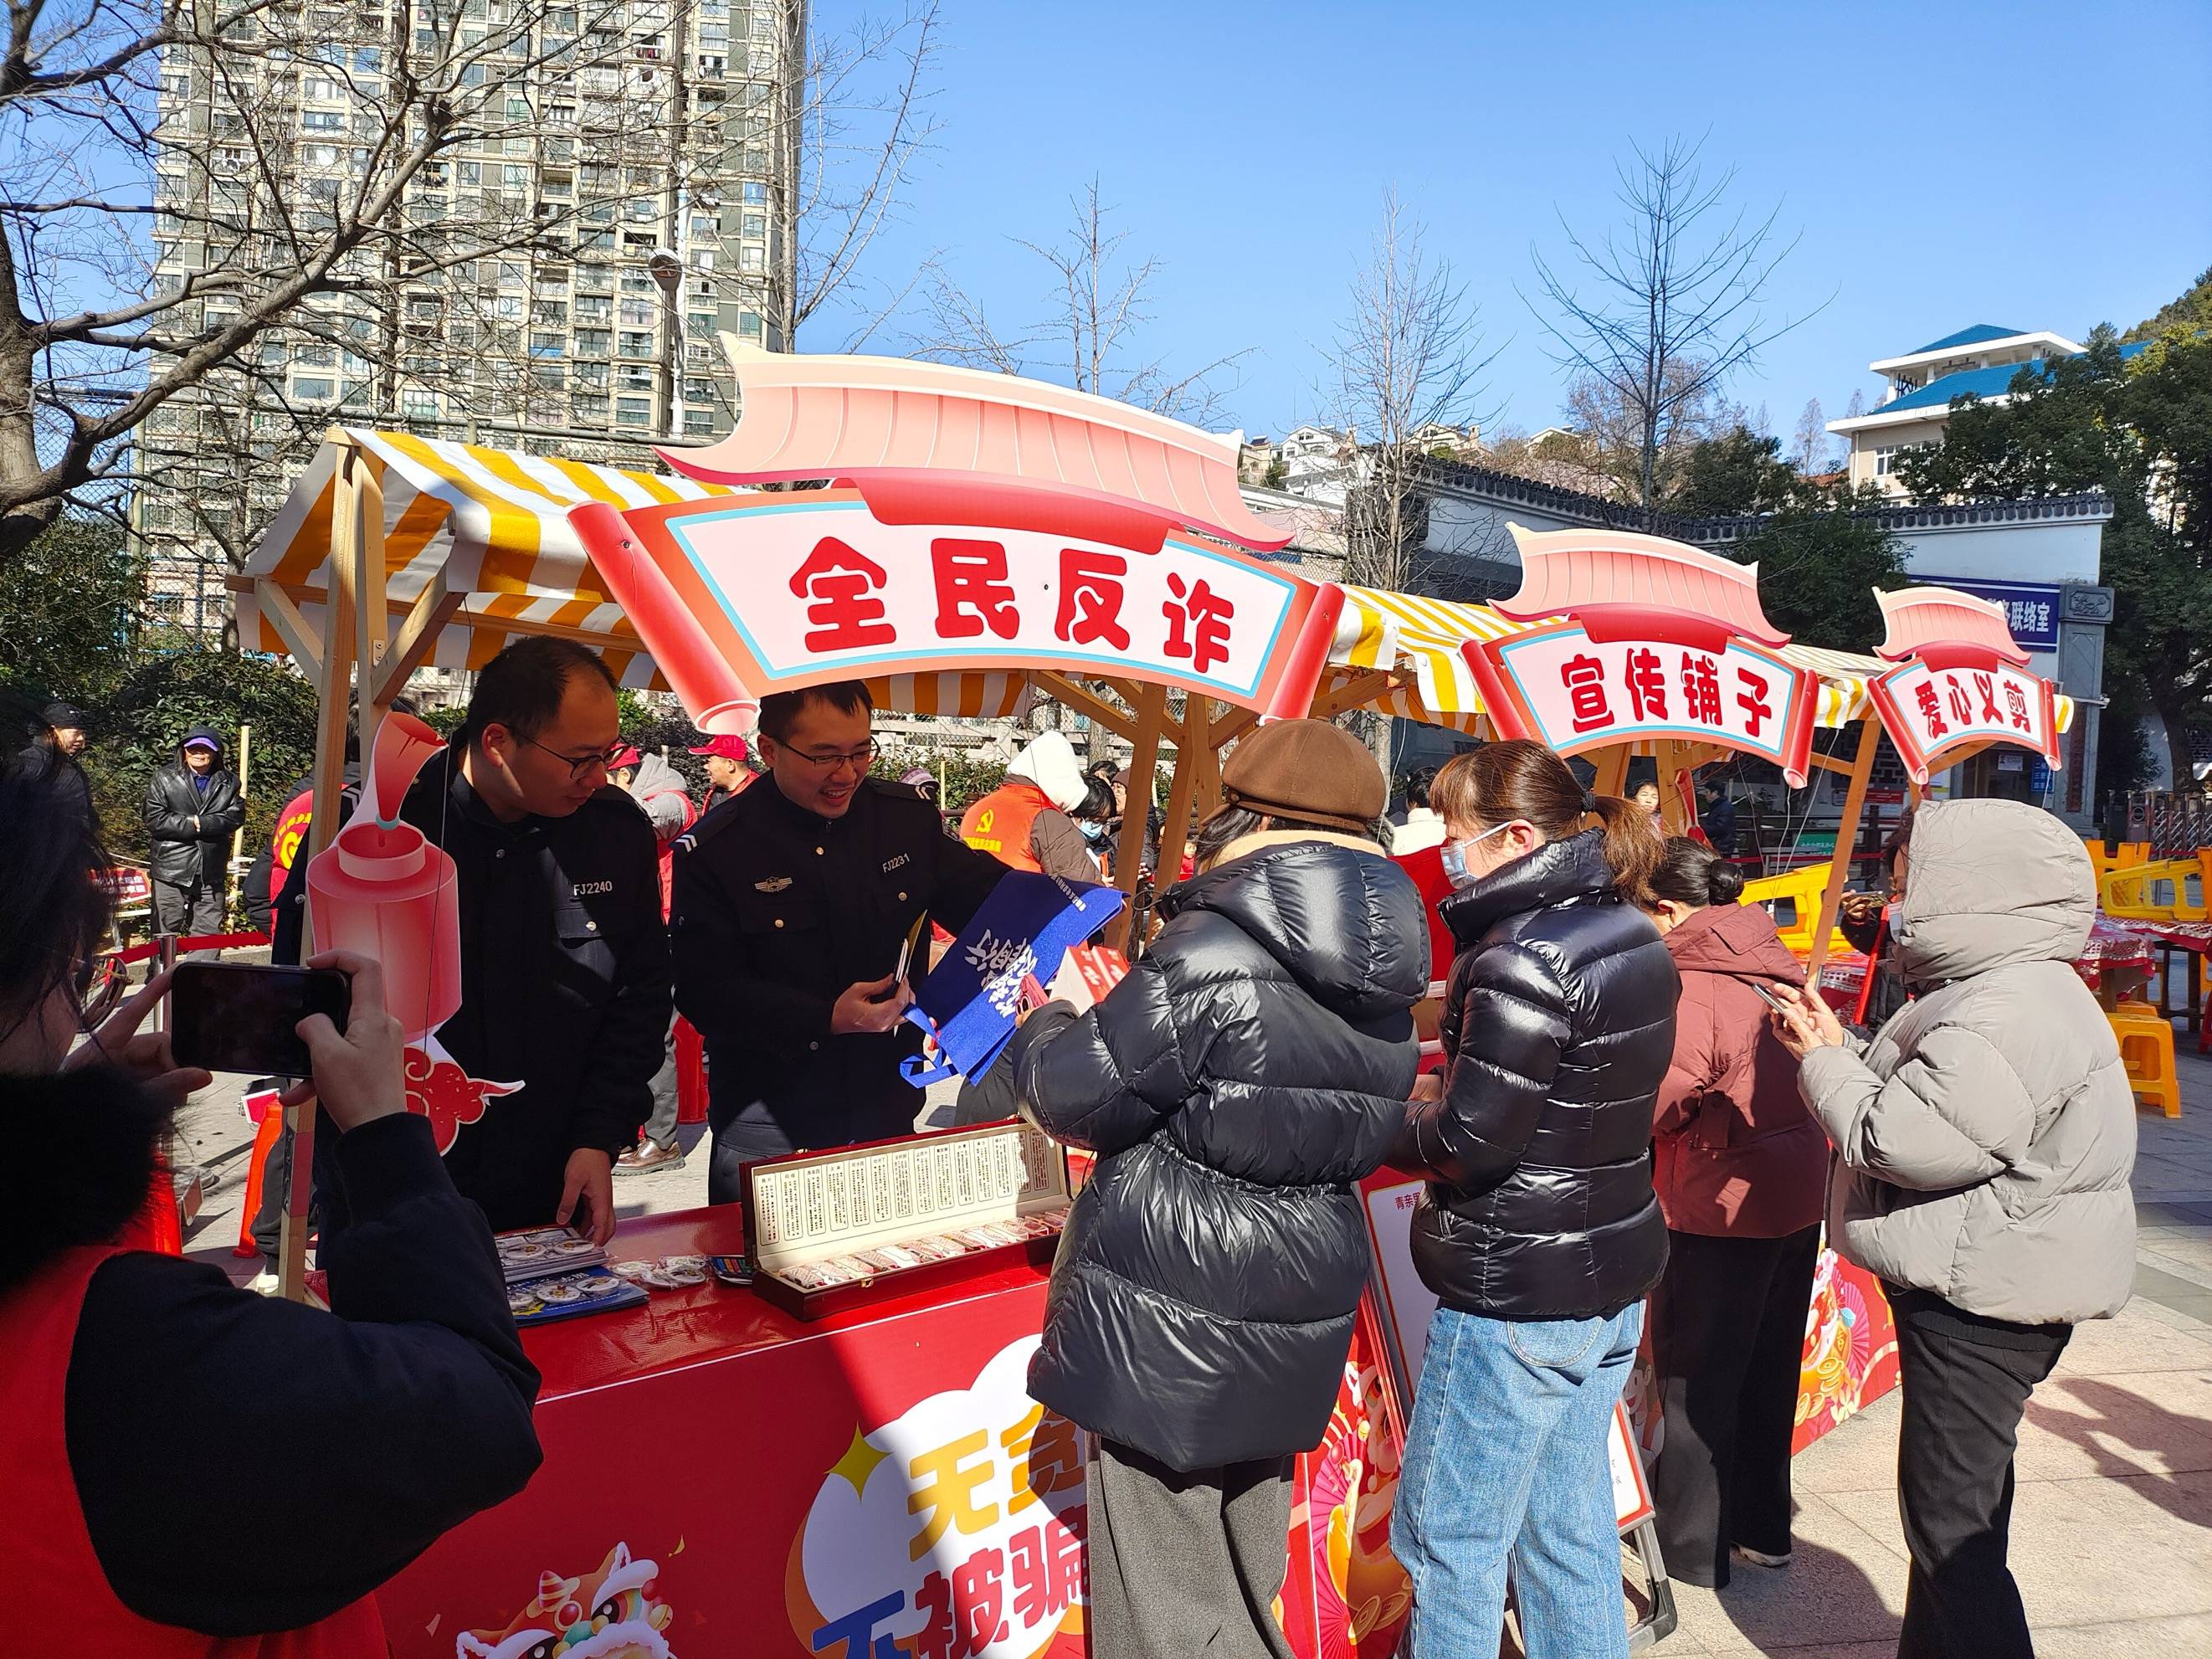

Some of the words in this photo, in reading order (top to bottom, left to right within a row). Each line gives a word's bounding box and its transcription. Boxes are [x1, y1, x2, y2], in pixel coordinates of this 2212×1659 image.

[788, 536, 1235, 674] 全民反诈
[1562, 647, 1773, 738] 宣传铺子
[1914, 672, 2031, 740] 爱心义剪
[572, 880, 613, 896] FJ2240
[881, 852, 911, 874] FJ2231
